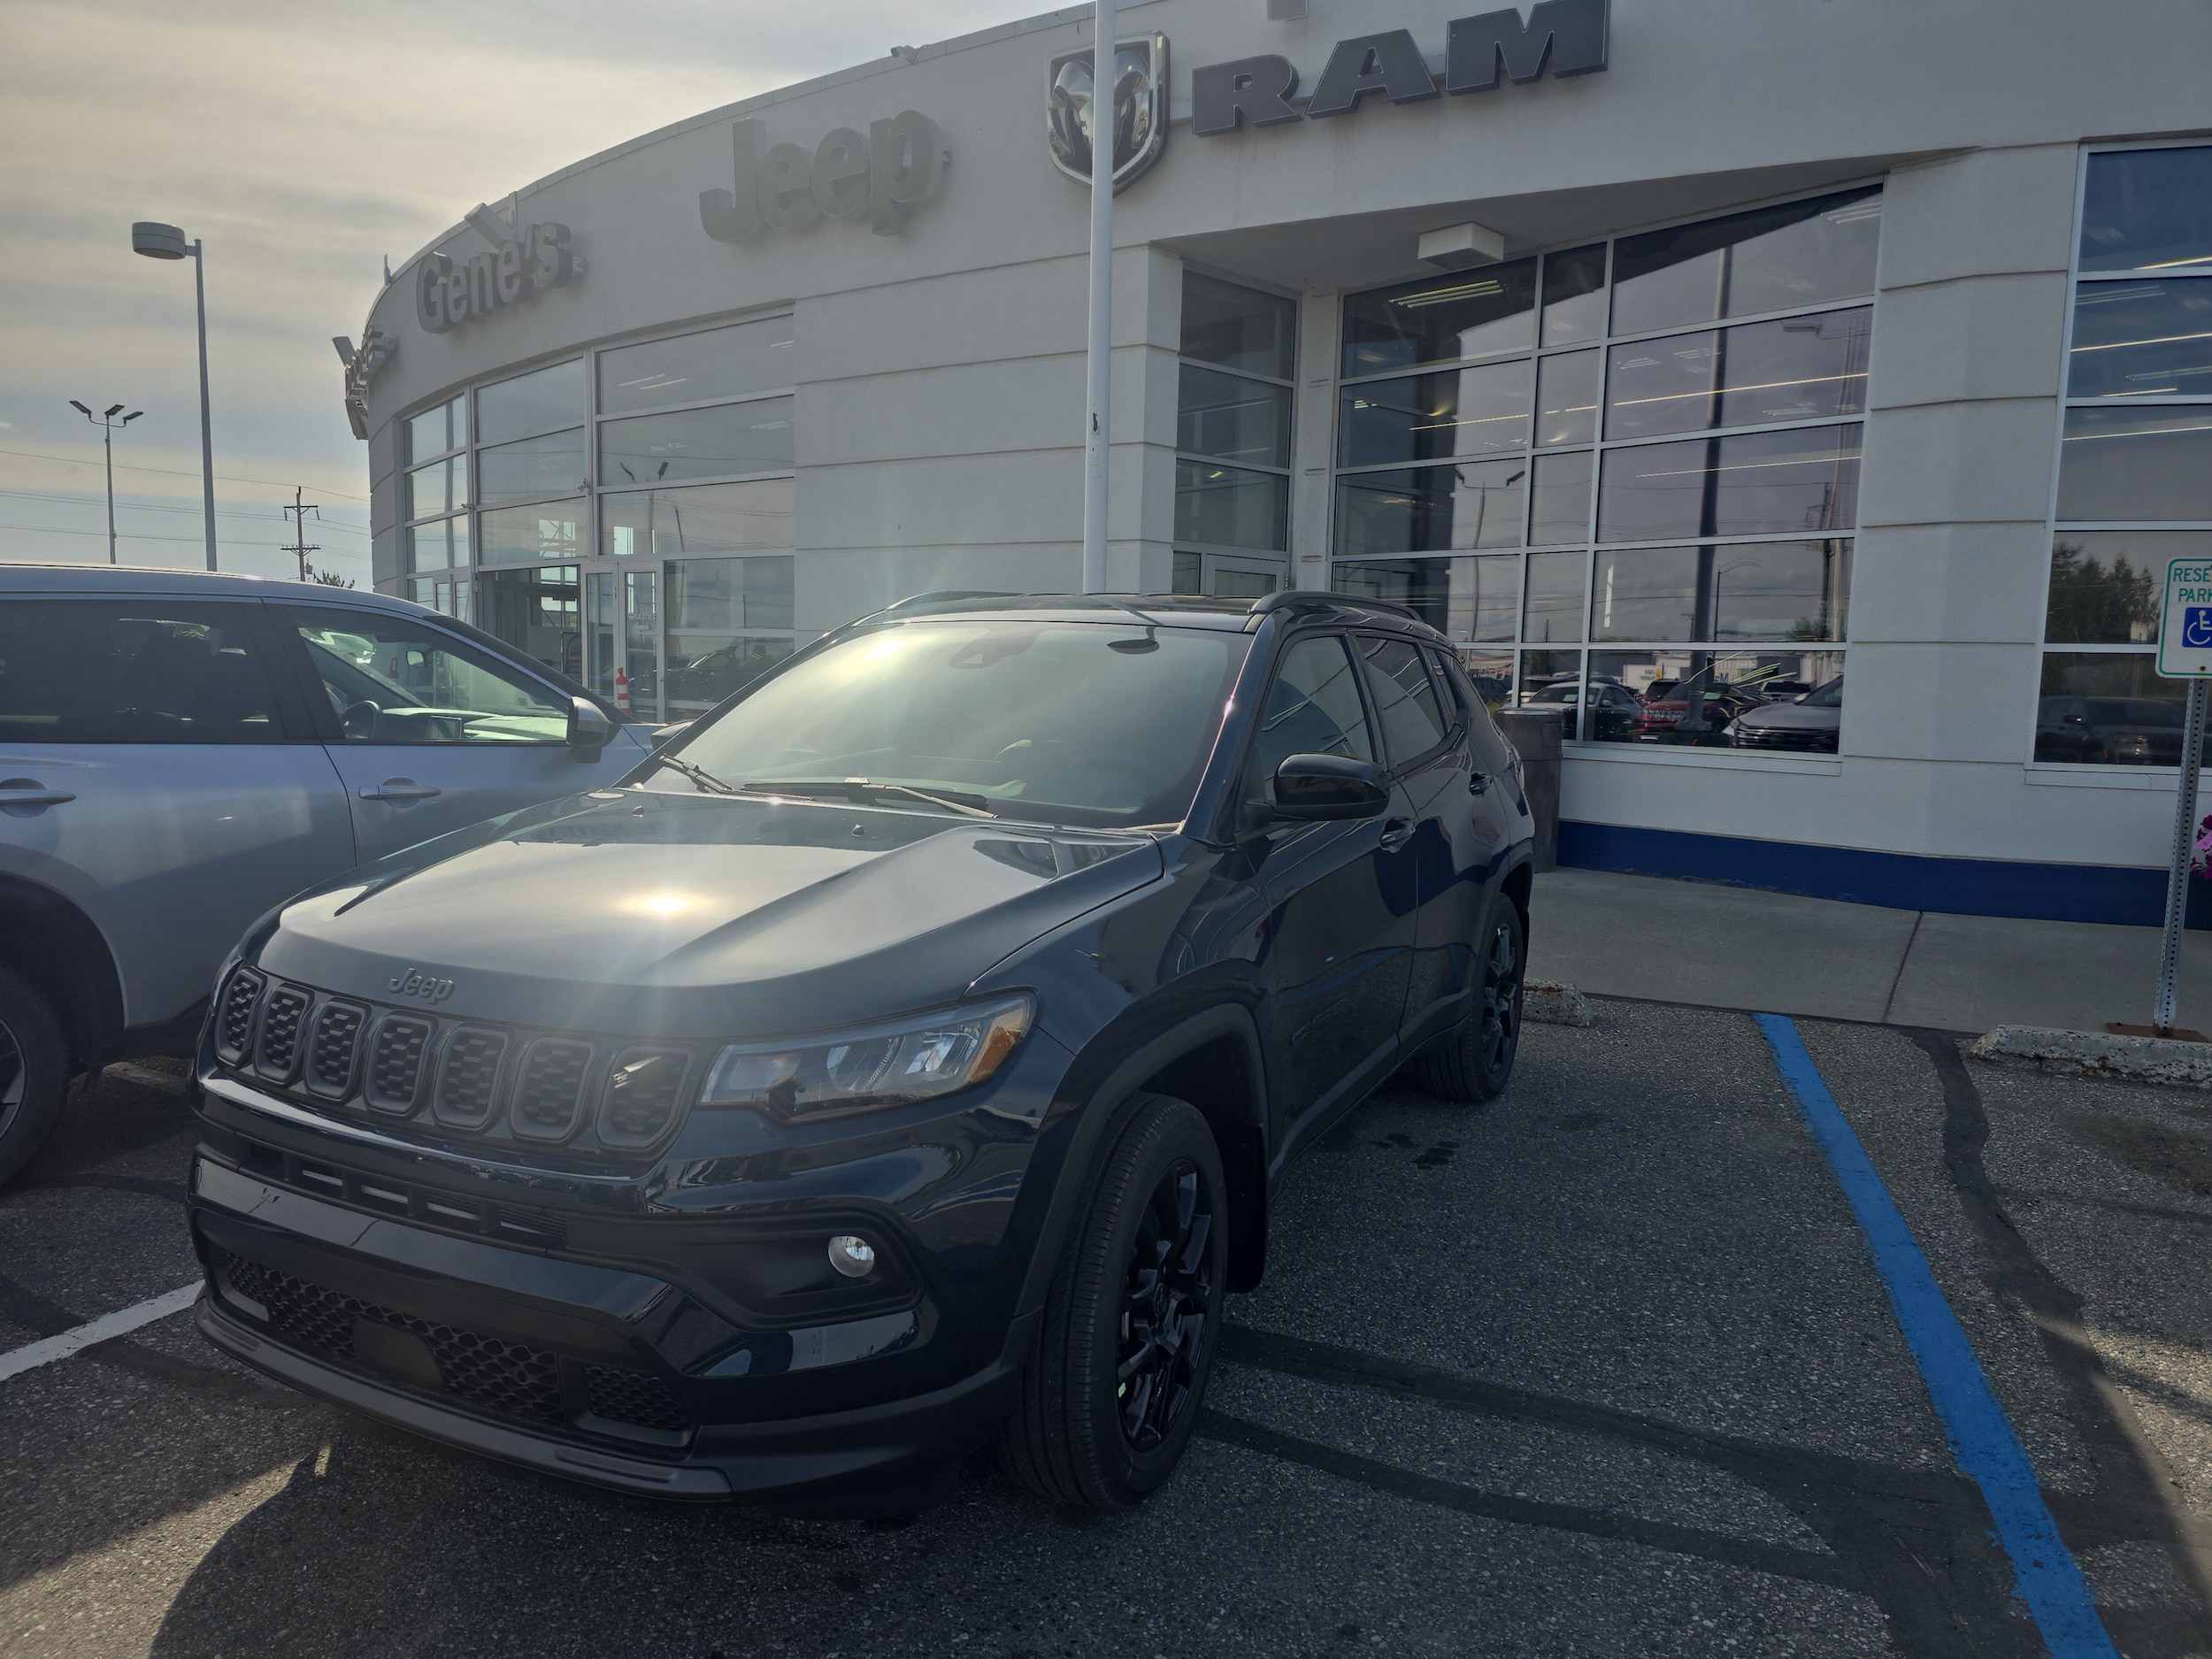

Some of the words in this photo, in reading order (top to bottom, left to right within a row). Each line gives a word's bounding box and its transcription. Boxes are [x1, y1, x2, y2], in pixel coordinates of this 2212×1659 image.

[1192, 0, 1609, 138] RAM
[699, 110, 941, 244] Jeep
[416, 221, 573, 334] Gene's
[388, 966, 455, 1005] Jeep
